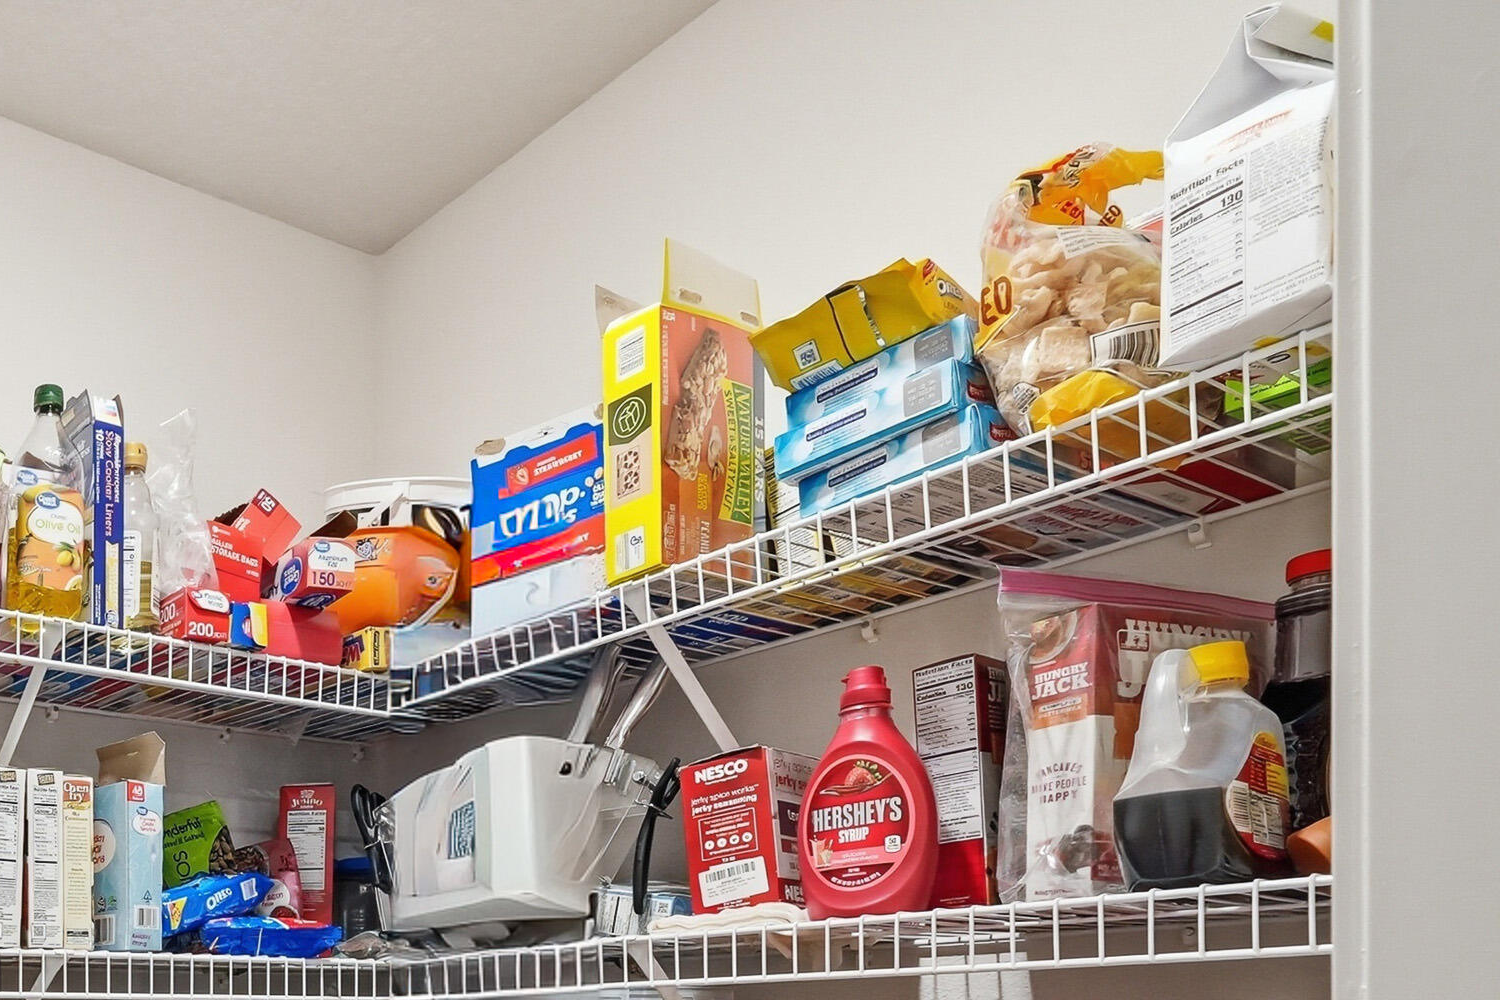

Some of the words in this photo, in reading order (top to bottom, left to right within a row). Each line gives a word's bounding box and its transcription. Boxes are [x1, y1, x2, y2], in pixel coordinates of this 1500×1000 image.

[1221, 189, 1243, 208] 130
[105, 430, 114, 458] Slow
[36, 519, 64, 531] Olive
[105, 504, 113, 536] Liners
[312, 572, 335, 586] 150
[188, 622, 213, 636] 200
[1035, 662, 1088, 684] HUNGRY
[955, 682, 974, 692] 130
[1032, 672, 1092, 700] JACK
[694, 759, 748, 784] NESCO
[63, 782, 89, 793] Oven
[812, 796, 902, 832] HERSHEY'S
[838, 827, 869, 843] SYRUP
[206, 887, 233, 911] OREO
